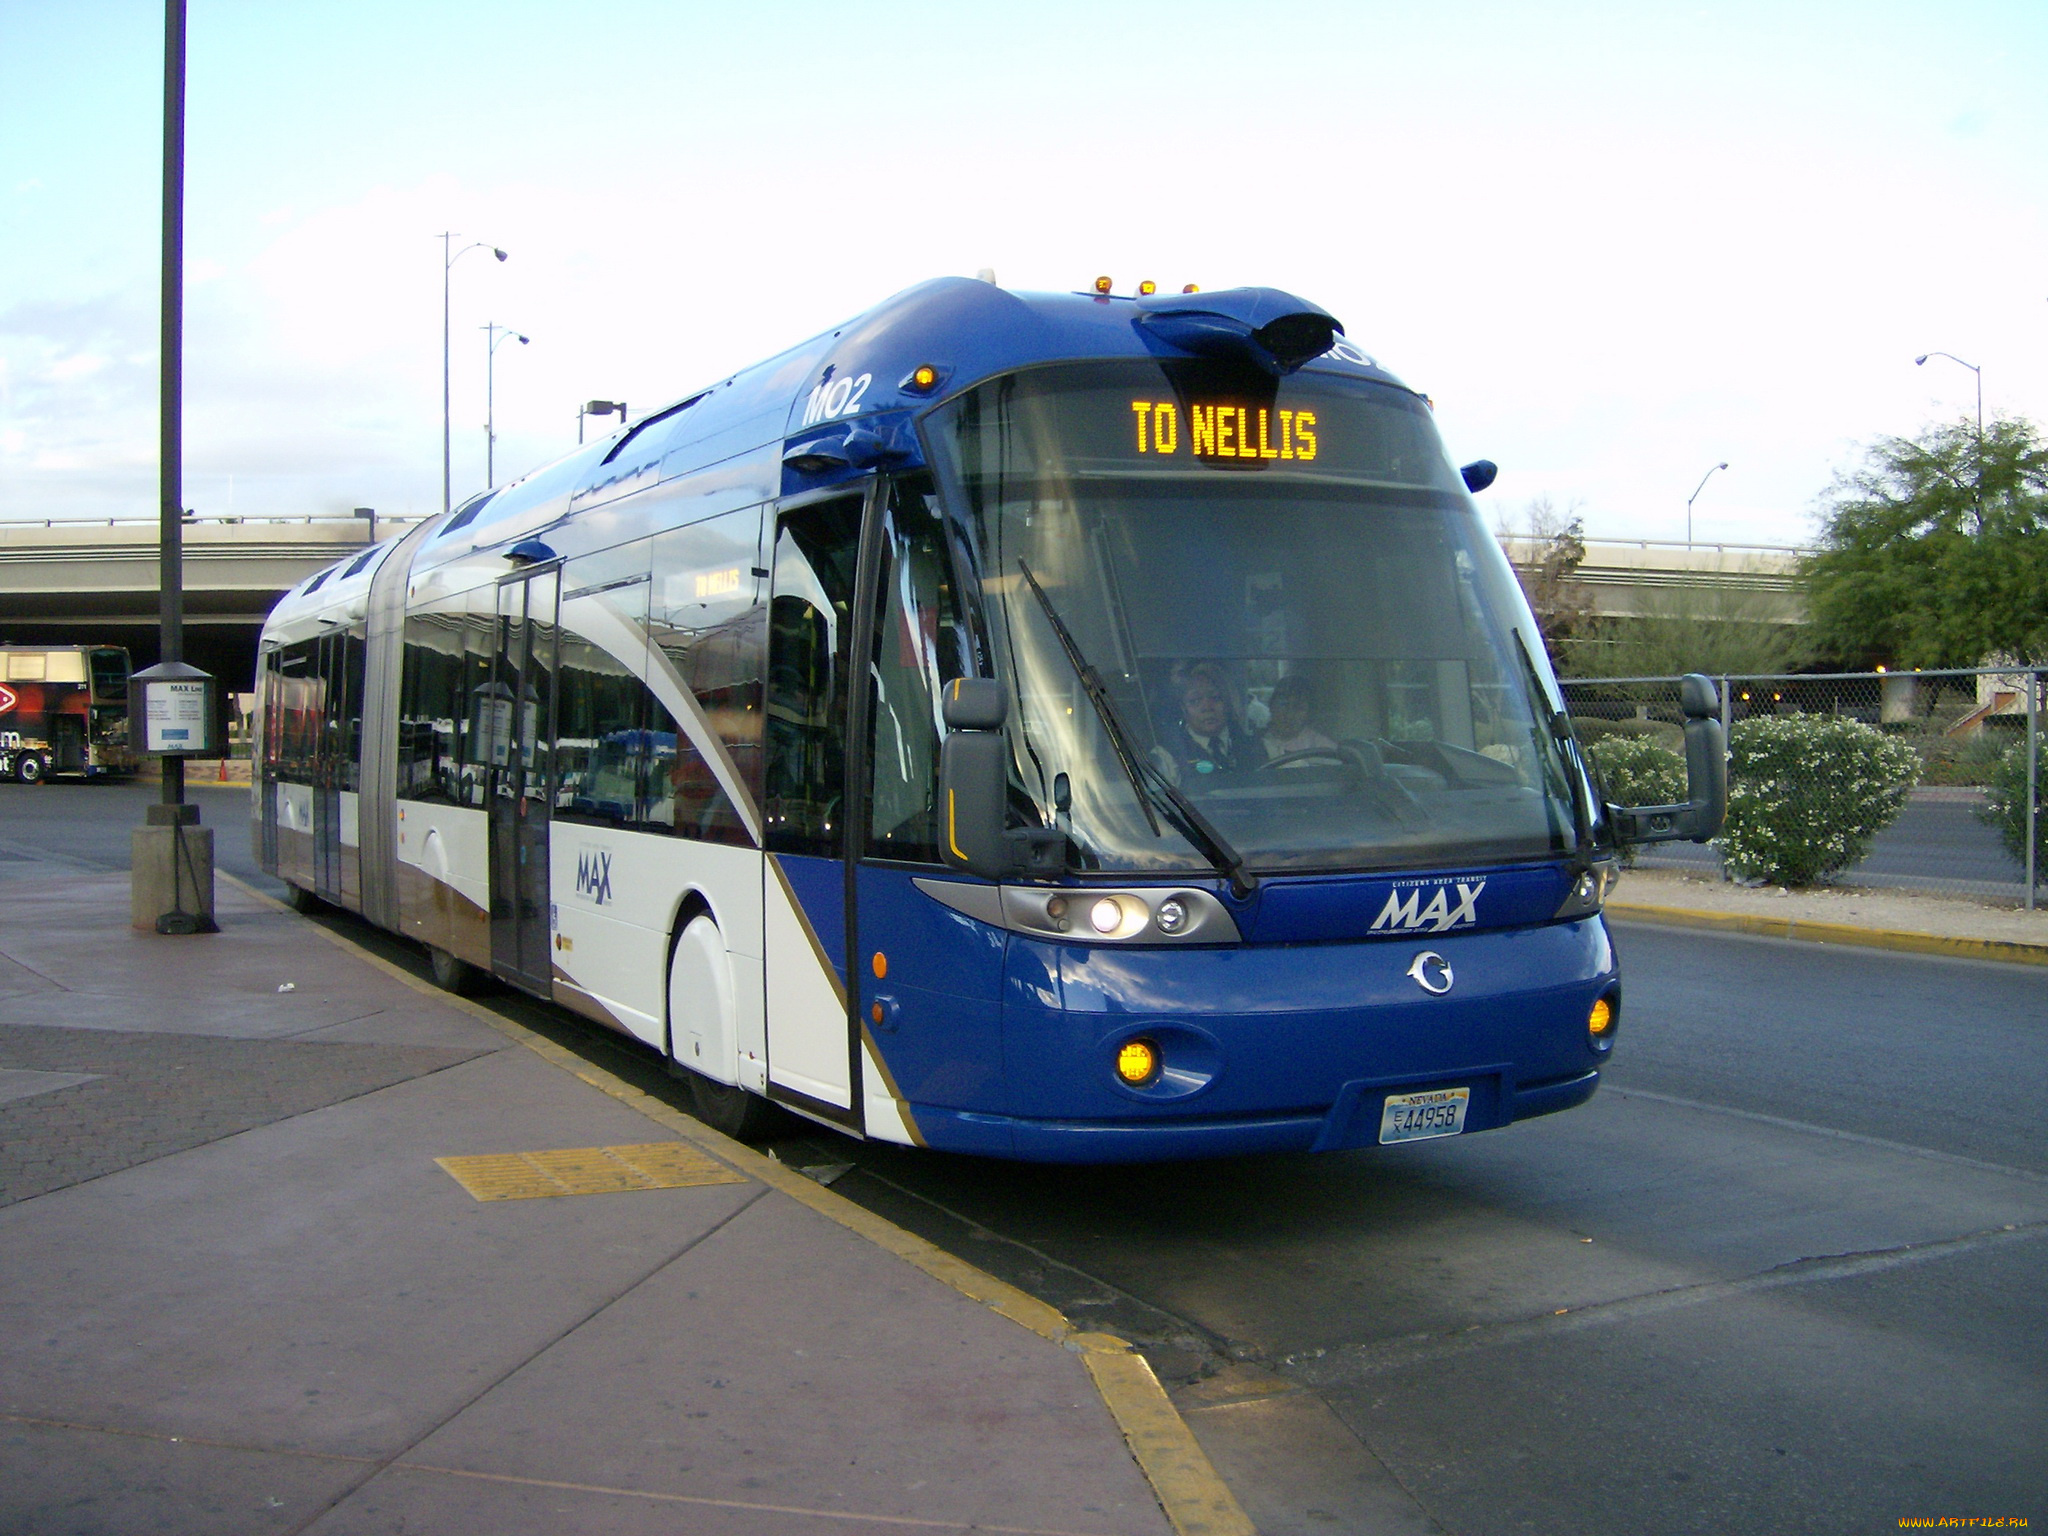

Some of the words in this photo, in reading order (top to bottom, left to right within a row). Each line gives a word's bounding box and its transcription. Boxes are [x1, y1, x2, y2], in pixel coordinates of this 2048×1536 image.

[1132, 401, 1177, 453] TO
[1192, 404, 1317, 460] NELLIS
[695, 575, 707, 598] TO
[708, 568, 740, 595] NELLIS
[576, 849, 612, 905] MAX
[1433, 877, 1453, 885] AREA
[1456, 875, 1487, 883] TRANSIT
[1369, 881, 1486, 933] MAX
[1409, 1093, 1447, 1105] NEVADA
[1403, 1104, 1457, 1132] 44958
